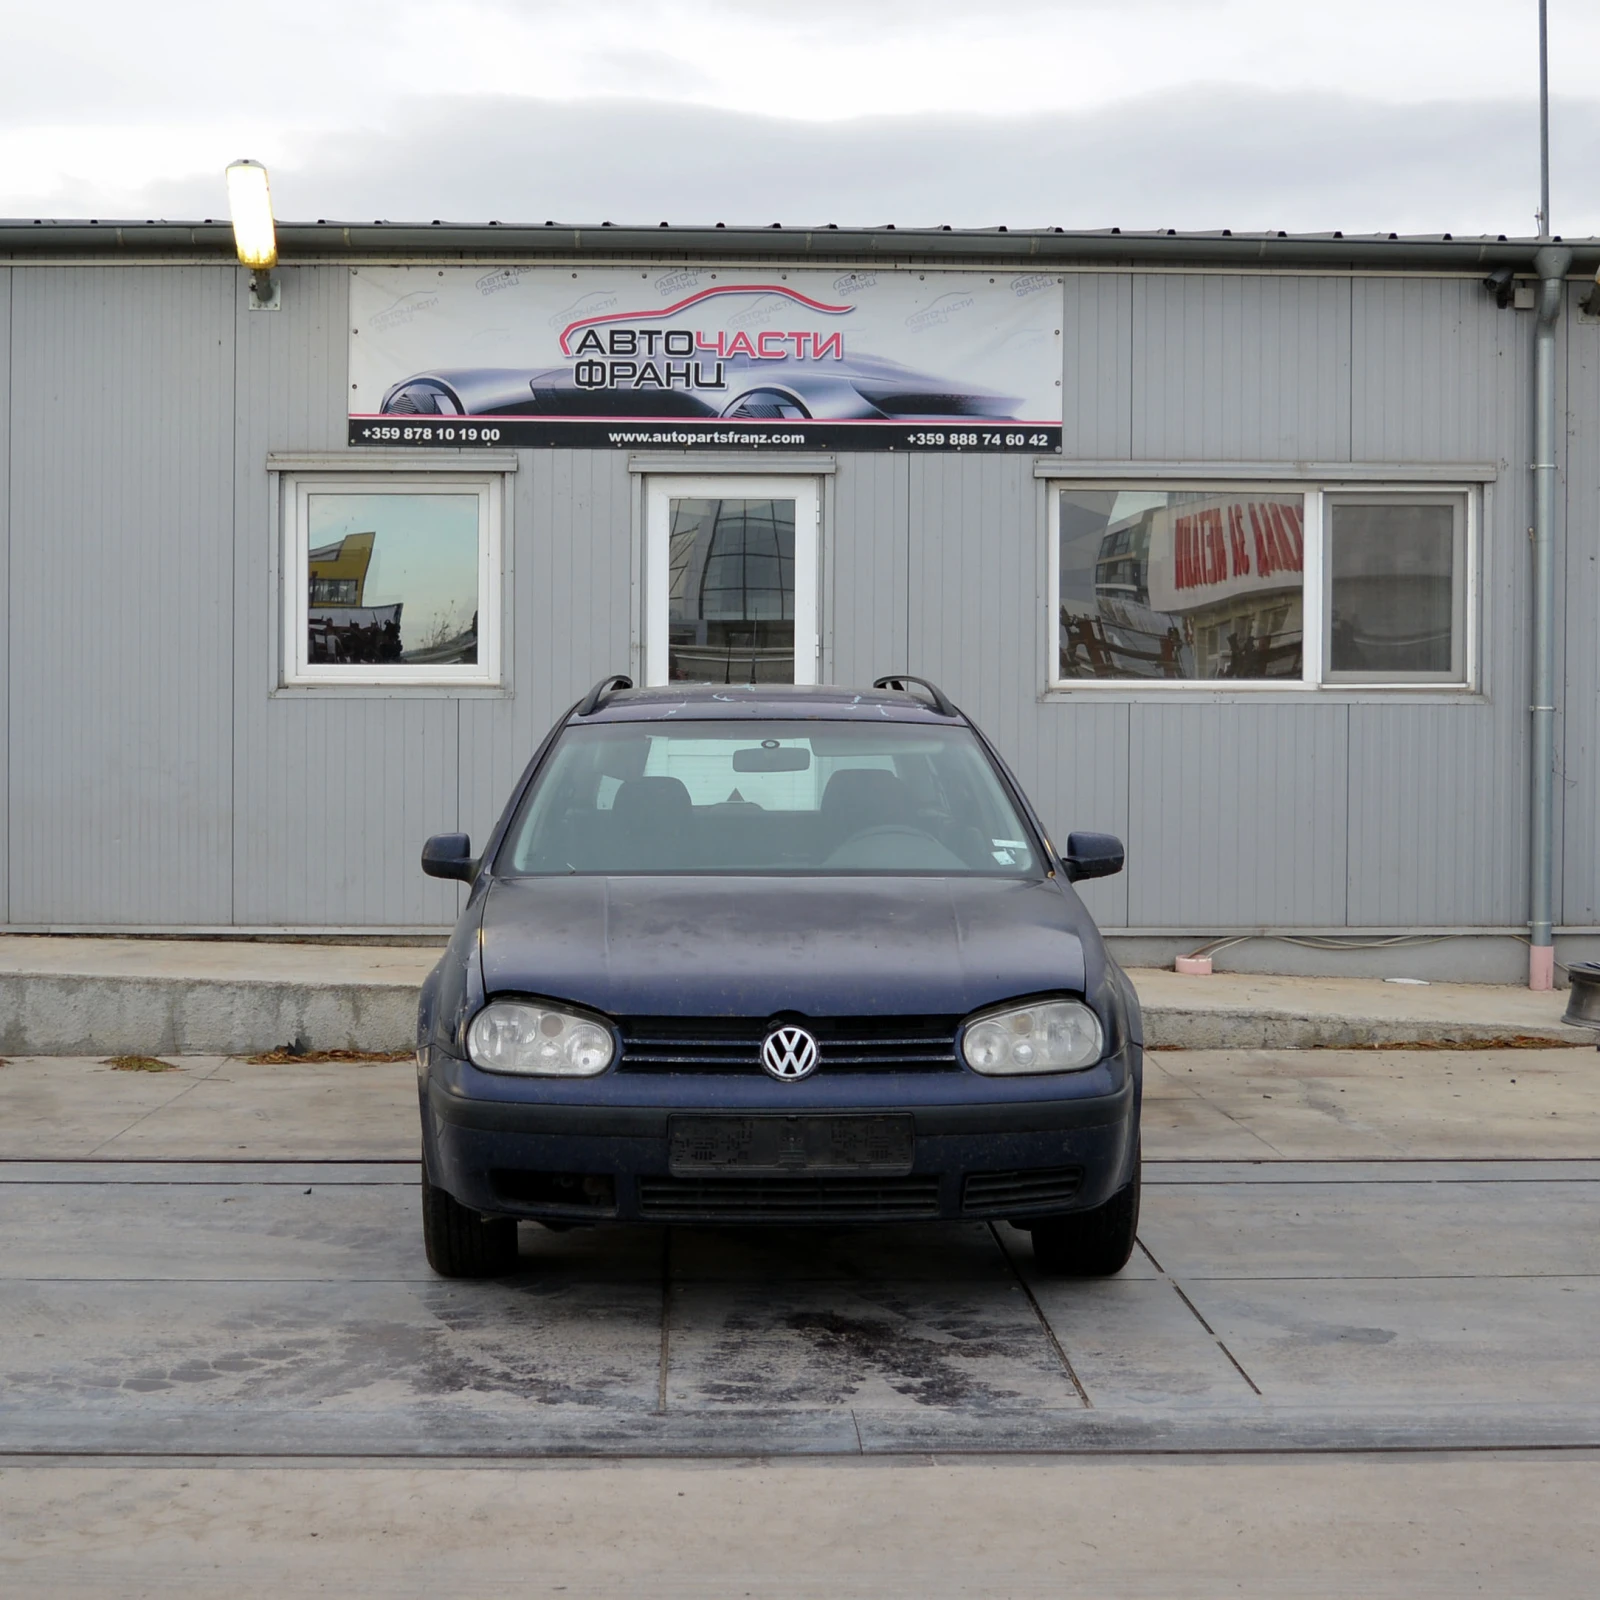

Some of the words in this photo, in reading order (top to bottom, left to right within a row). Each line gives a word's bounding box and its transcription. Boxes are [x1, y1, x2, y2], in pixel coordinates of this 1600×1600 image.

[576, 329, 842, 359] АВТОЧАСТИ
[575, 359, 726, 389] ФРАНЦ
[362, 427, 401, 440] +359
[404, 427, 433, 440] 878
[436, 428, 455, 440] 10
[458, 428, 478, 441] 19
[480, 428, 501, 441] 00
[608, 431, 806, 447] www.autopartsfranz.com
[907, 432, 945, 446] +359
[949, 433, 979, 446] 888
[982, 433, 1002, 446] 74
[1006, 433, 1025, 446] 60
[1028, 433, 1048, 446] 42
